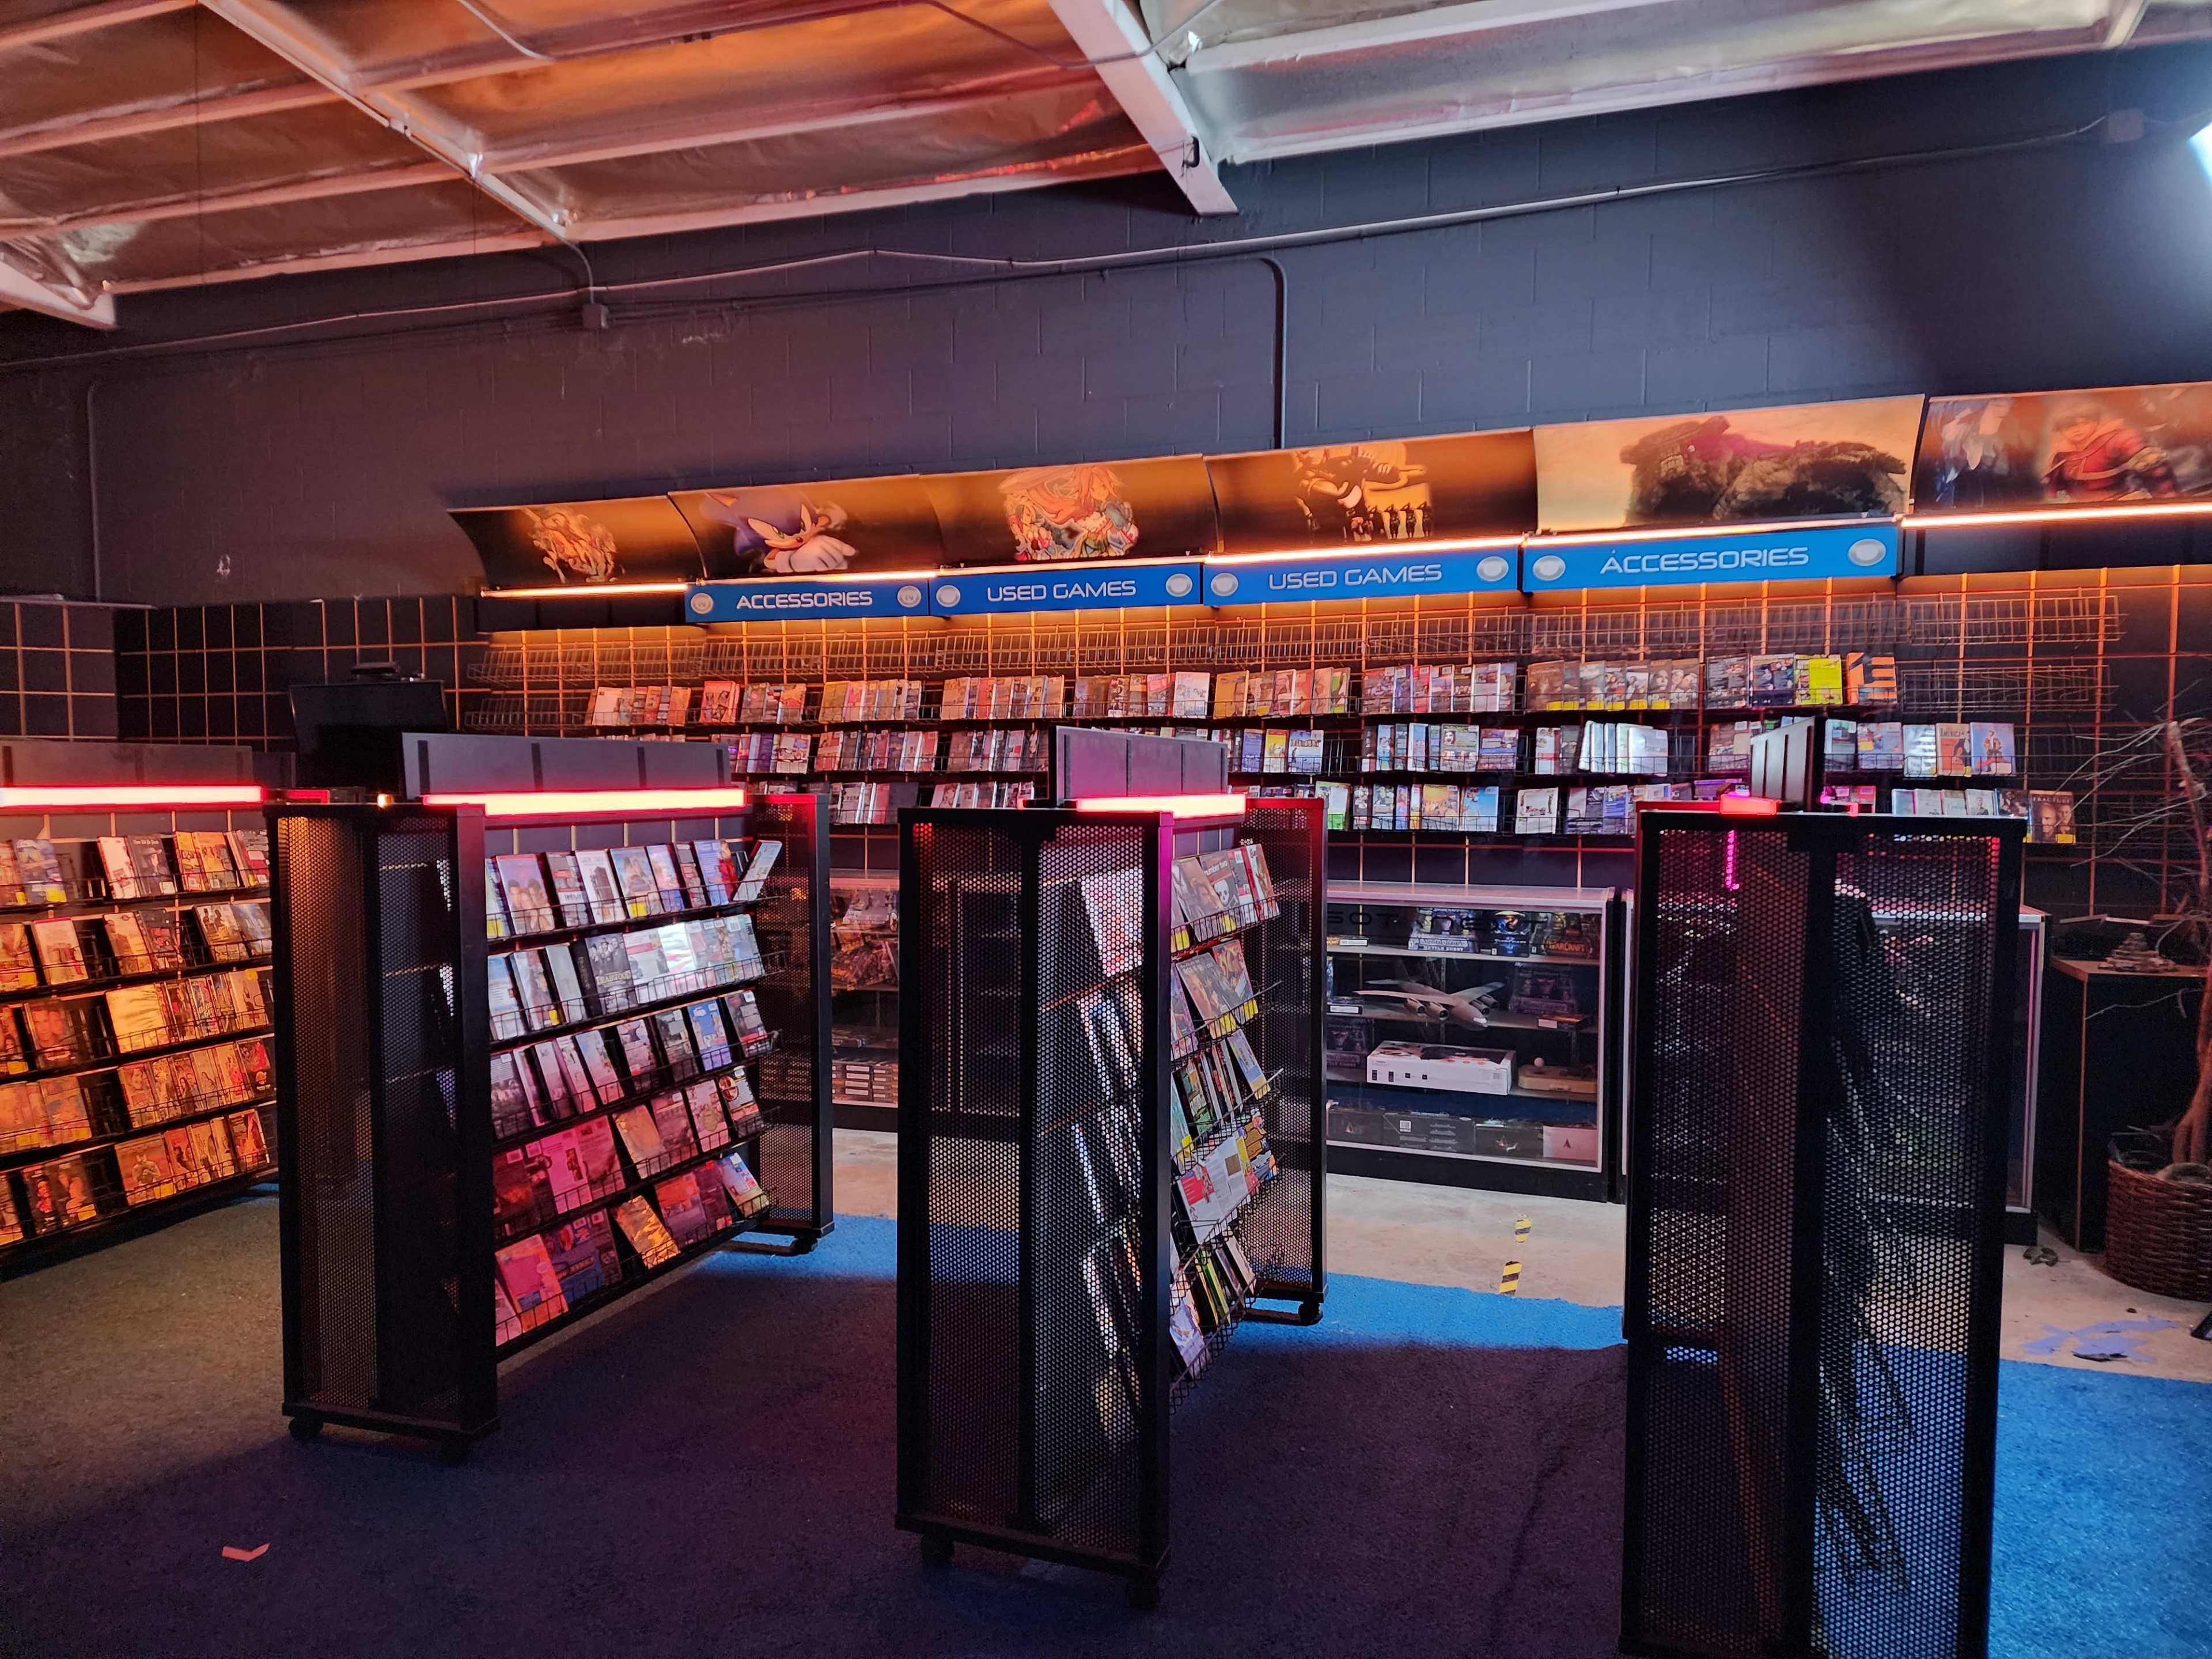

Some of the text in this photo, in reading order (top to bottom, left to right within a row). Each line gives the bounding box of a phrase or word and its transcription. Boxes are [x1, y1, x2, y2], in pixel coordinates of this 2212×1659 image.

[1600, 547, 1809, 574] ACCESSORIES
[1268, 564, 1442, 590] USED GAMES
[736, 590, 874, 610] ACCESSORIES
[987, 579, 1137, 603] USED GAMES
